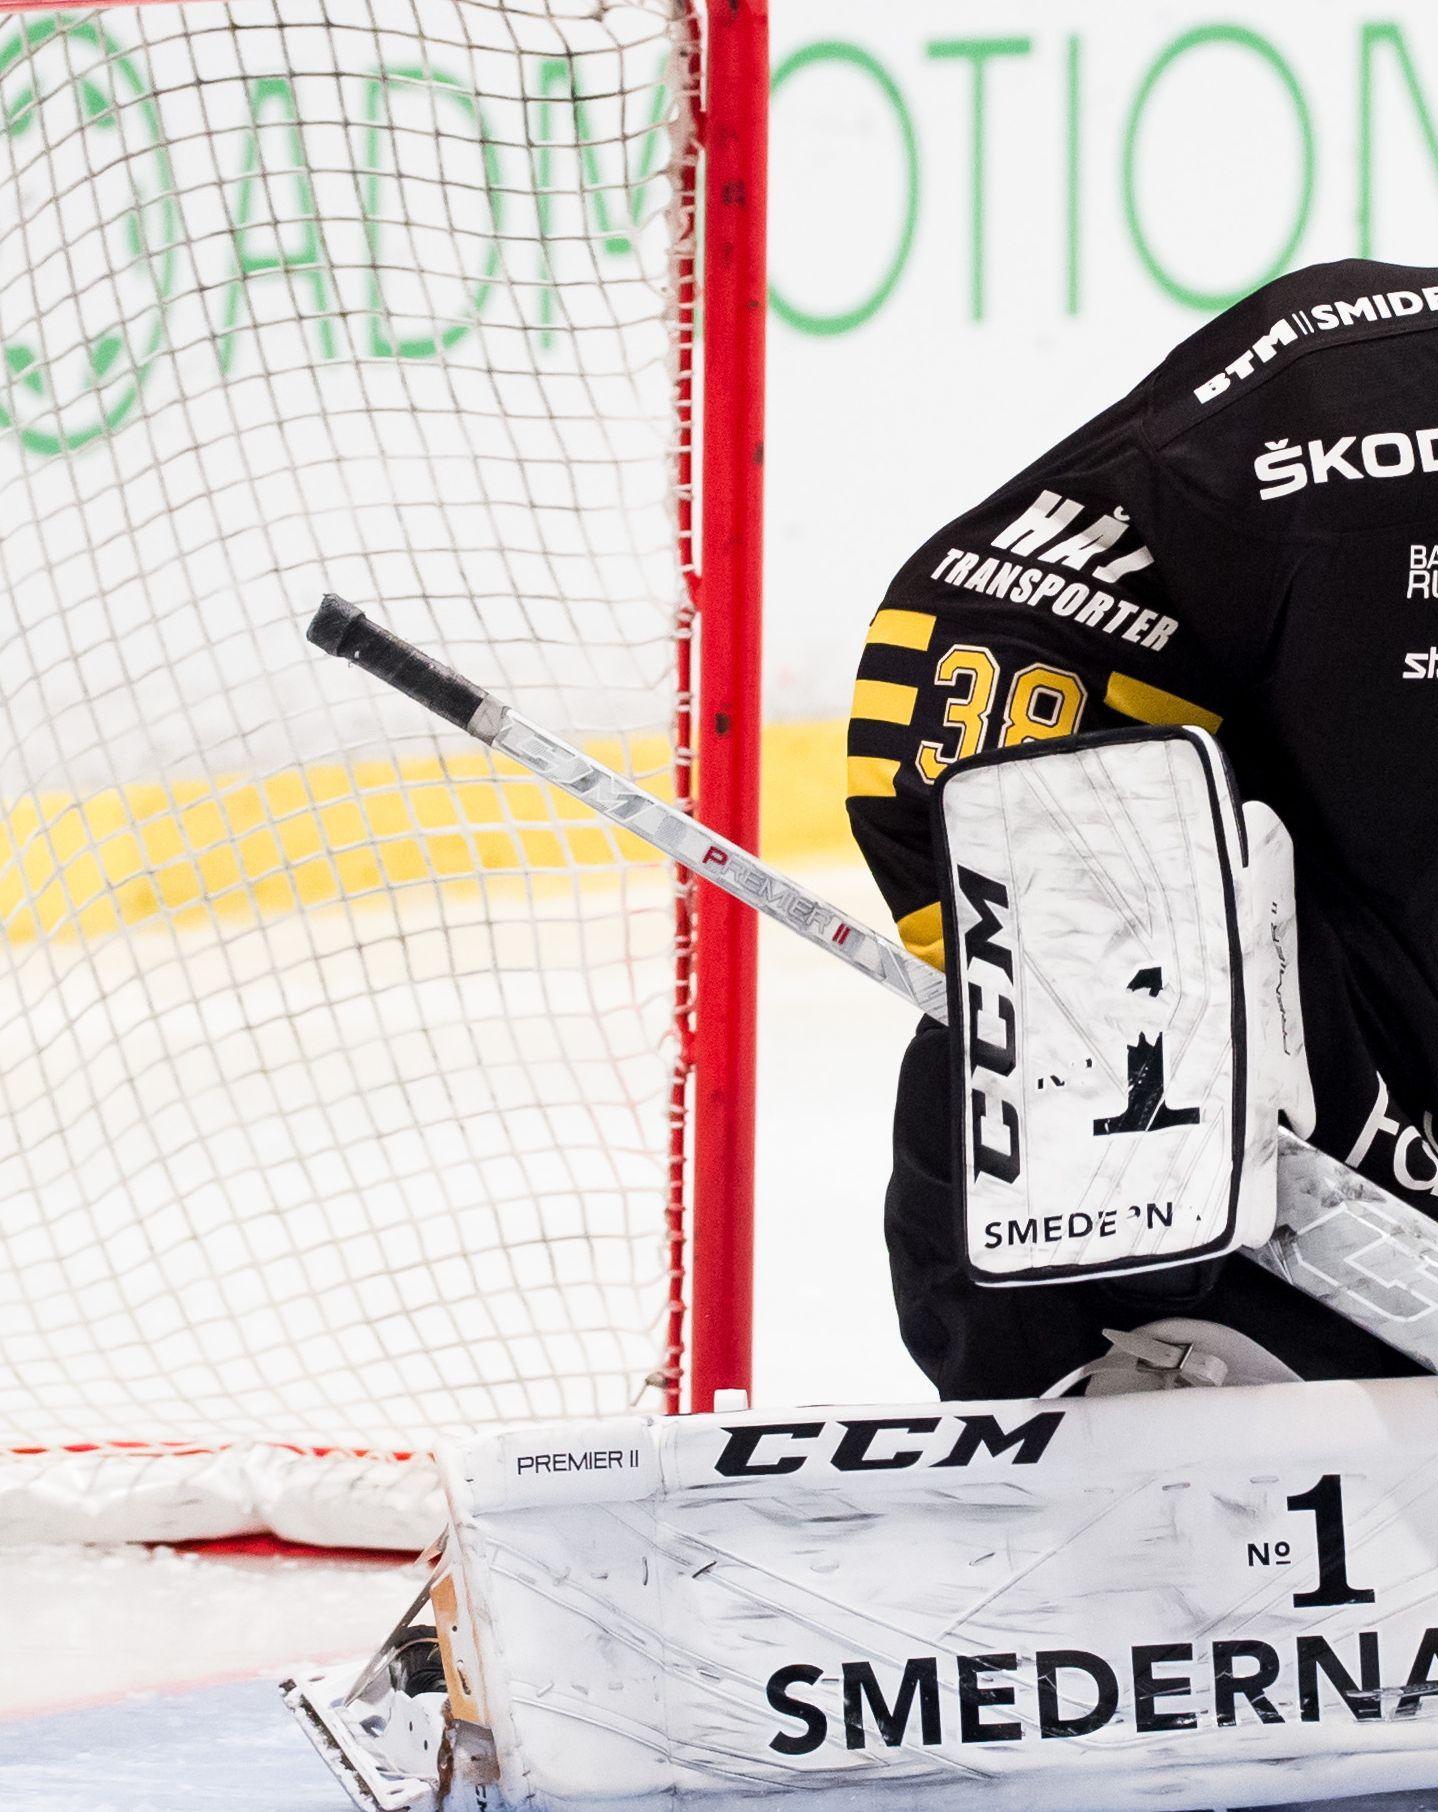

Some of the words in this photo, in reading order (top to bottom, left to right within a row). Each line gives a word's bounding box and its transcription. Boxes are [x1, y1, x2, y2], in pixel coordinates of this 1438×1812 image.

[930, 548, 1179, 651] TRANSPORTER
[915, 643, 1088, 785] 38
[702, 845, 832, 935] PREMIER
[957, 864, 1022, 1185] CCM
[984, 1202, 1202, 1249] SMEDEN
[517, 1450, 623, 1475] PREMIER
[714, 1411, 1067, 1478] CCM
[1286, 1474, 1376, 1608] 1
